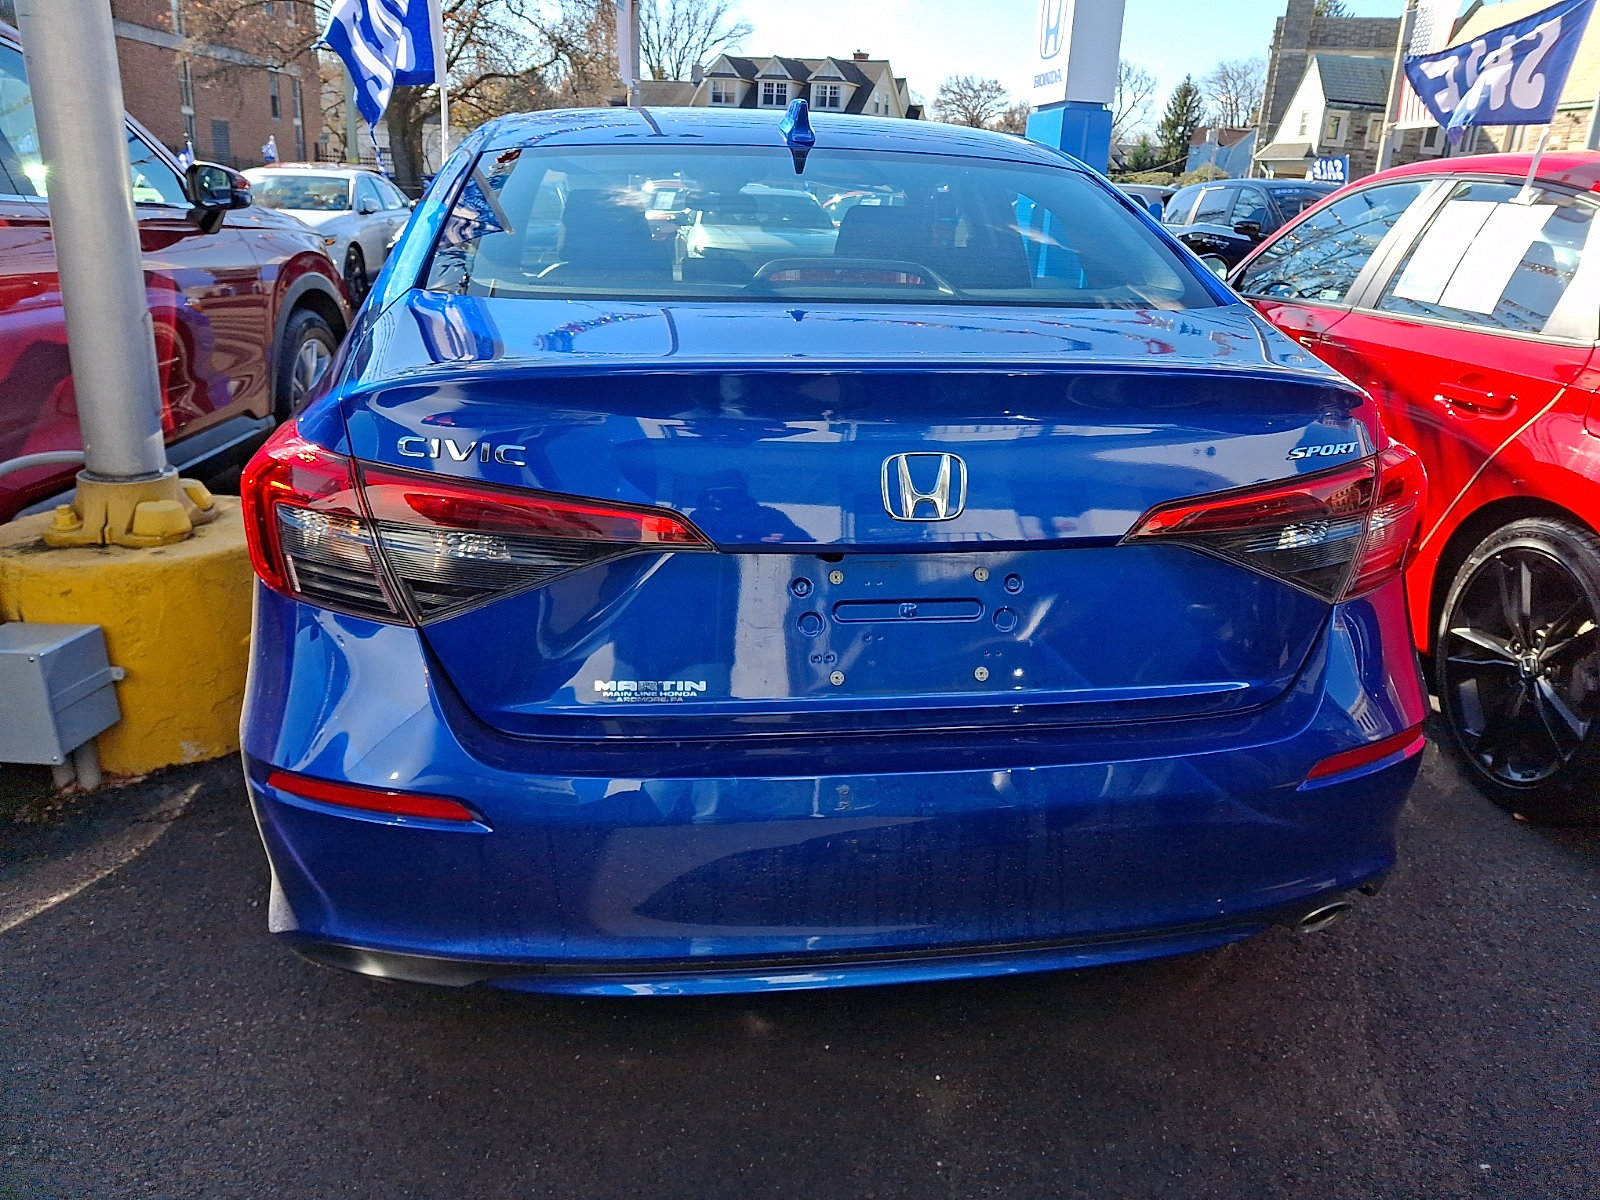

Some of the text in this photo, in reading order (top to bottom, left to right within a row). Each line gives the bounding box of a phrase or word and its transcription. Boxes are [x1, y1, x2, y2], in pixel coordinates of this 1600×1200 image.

[396, 435, 526, 466] CIVIC
[1287, 441, 1359, 460] SPORT
[594, 680, 706, 691] MARTIN
